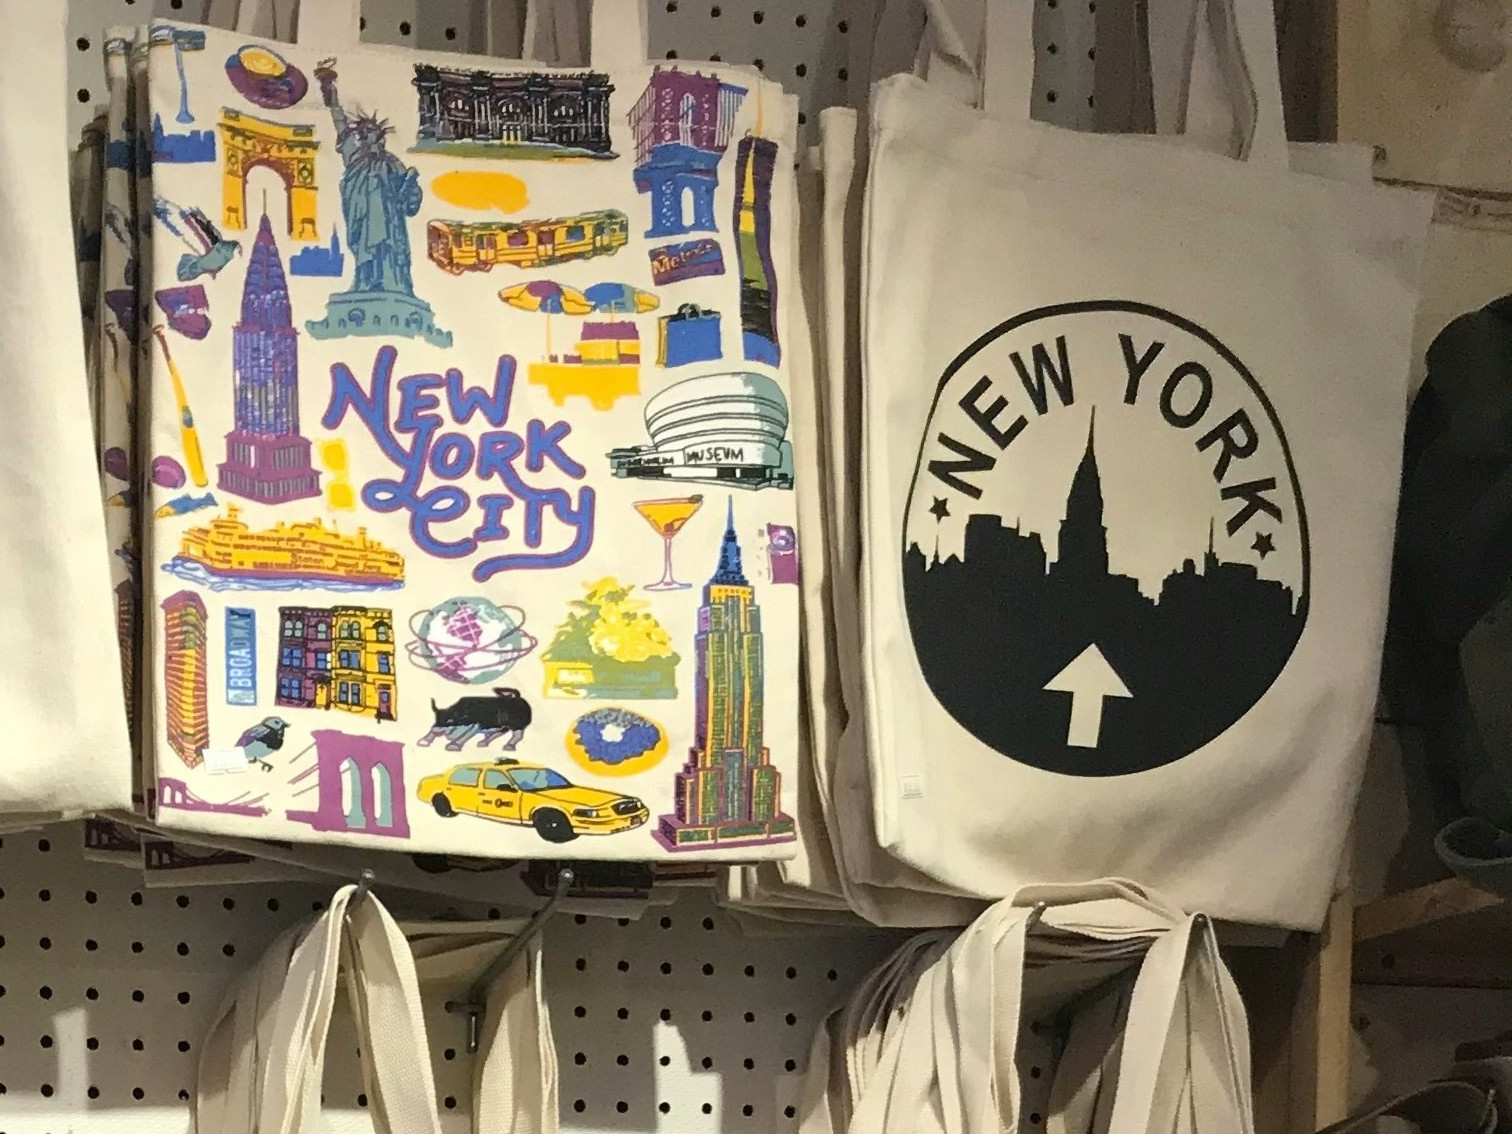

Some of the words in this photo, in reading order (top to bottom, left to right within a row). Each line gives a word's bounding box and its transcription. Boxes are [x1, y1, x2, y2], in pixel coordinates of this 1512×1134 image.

[321, 345, 518, 436] NEW
[926, 335, 1076, 500] NEW
[1117, 332, 1284, 538] YORK
[381, 418, 587, 498] YORK
[361, 484, 597, 583] CITY
